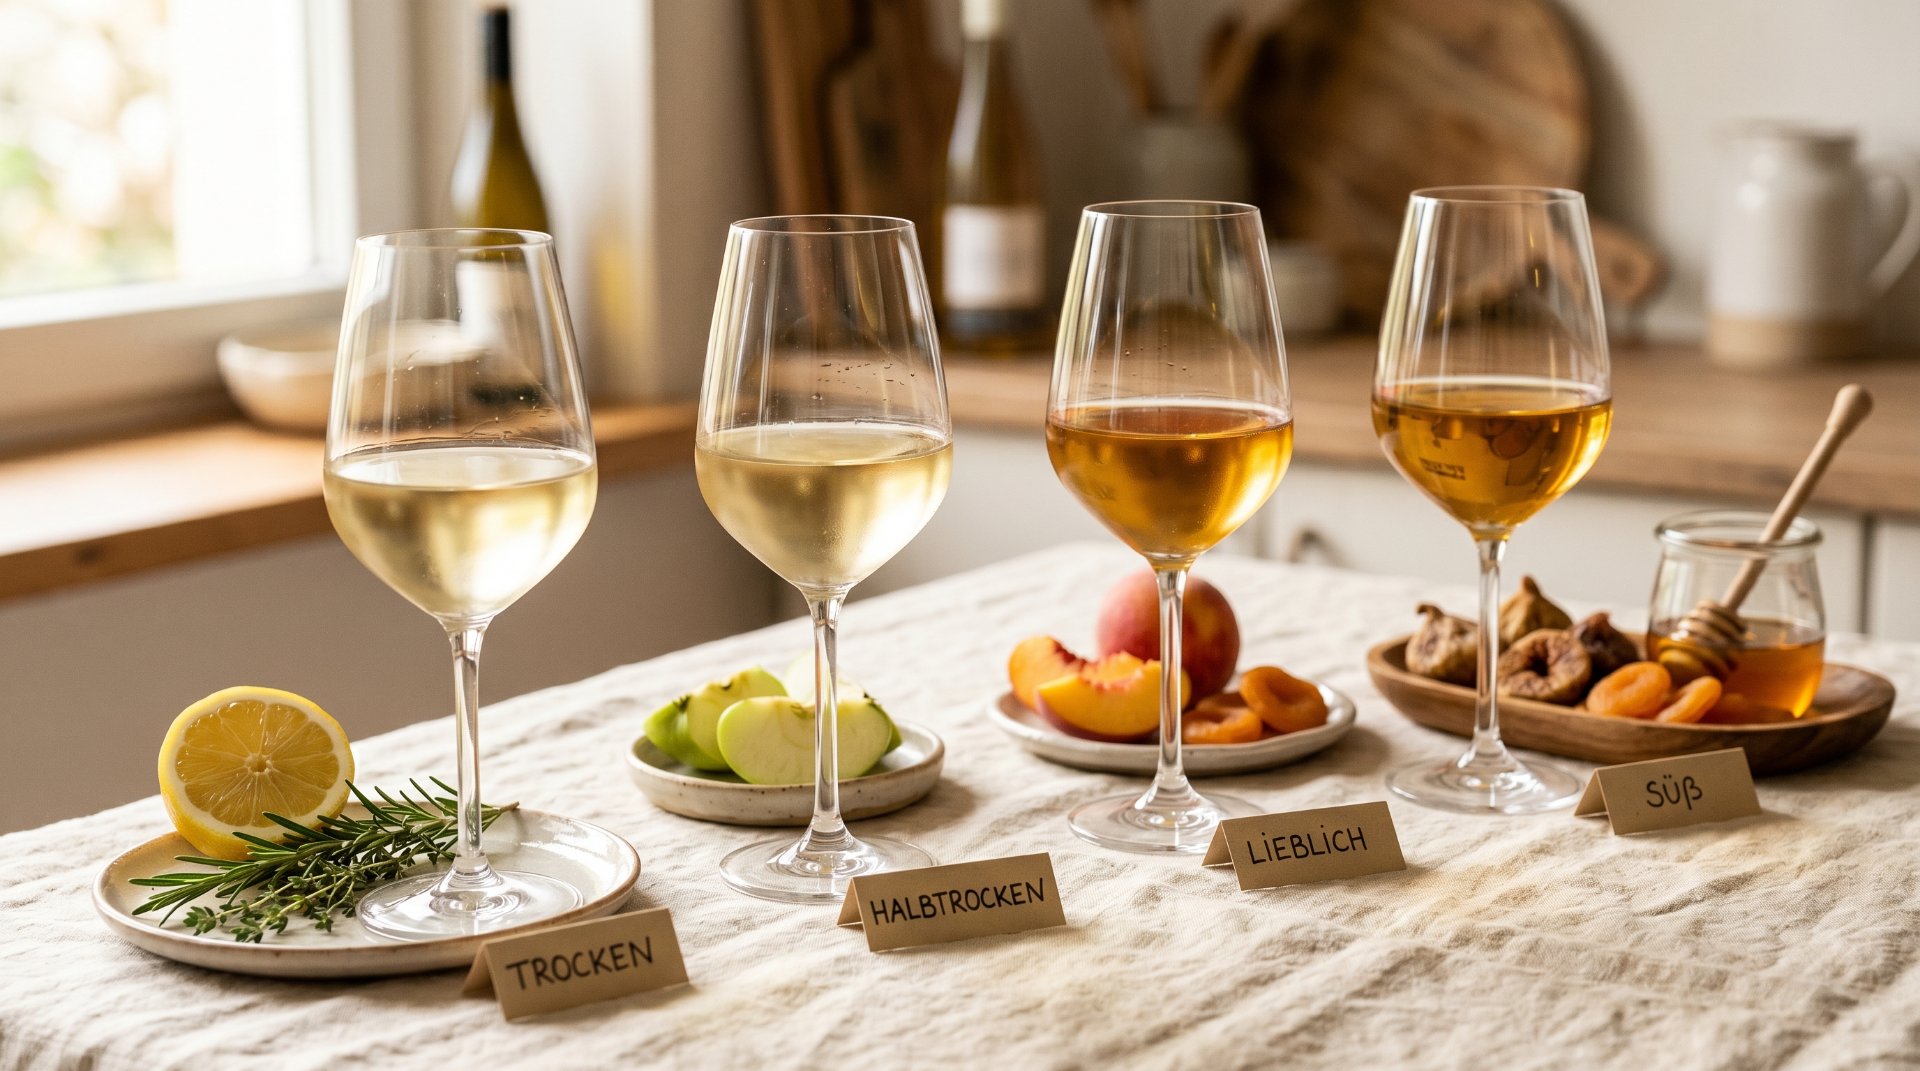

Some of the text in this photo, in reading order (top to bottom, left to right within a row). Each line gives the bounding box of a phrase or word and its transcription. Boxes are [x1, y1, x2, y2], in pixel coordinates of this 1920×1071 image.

[1646, 774, 1703, 811] SÜß
[869, 877, 1045, 926] HALBTROCKEN
[506, 936, 654, 990] TROCKEN
